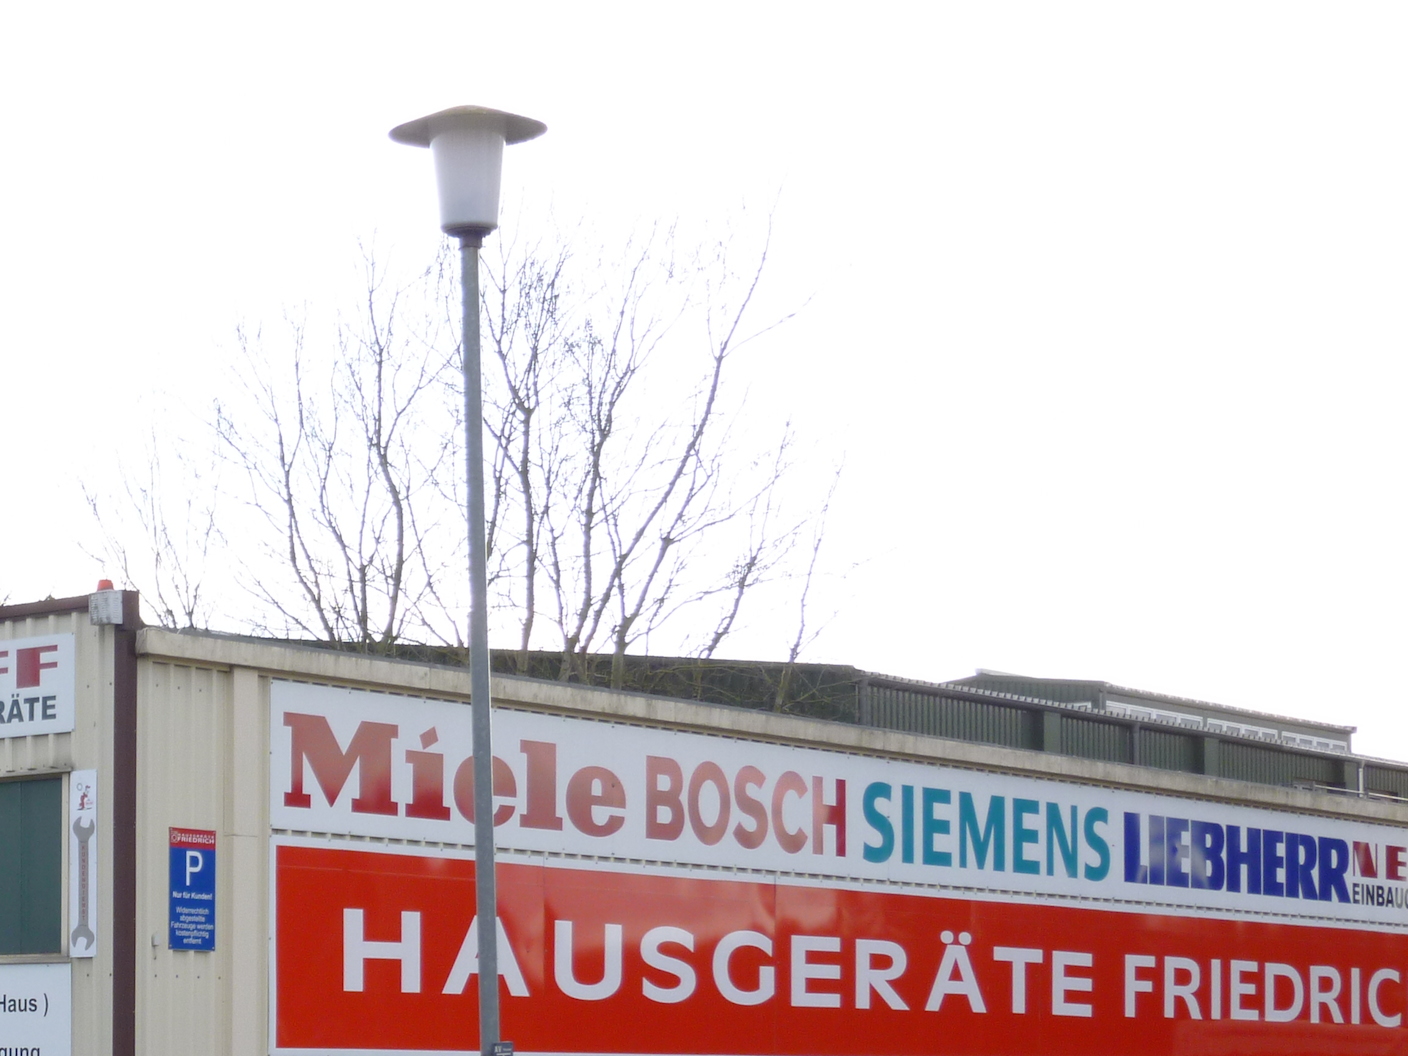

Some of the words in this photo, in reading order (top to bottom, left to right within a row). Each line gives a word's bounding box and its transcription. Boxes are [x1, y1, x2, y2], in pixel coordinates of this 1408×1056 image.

[283, 711, 626, 838] Miele
[645, 755, 847, 858] BOSCH
[177, 836, 215, 844] FRIEDRICH
[185, 850, 203, 886] P
[862, 781, 1111, 882] SIEMENS
[1123, 811, 1352, 904] LIEBHERR
[172, 891, 182, 899] Nur
[182, 891, 190, 899] für
[191, 892, 213, 900] Kunden!
[1352, 882, 1408, 909] EINBAU
[342, 907, 1093, 1018] HAUSGERÄTE
